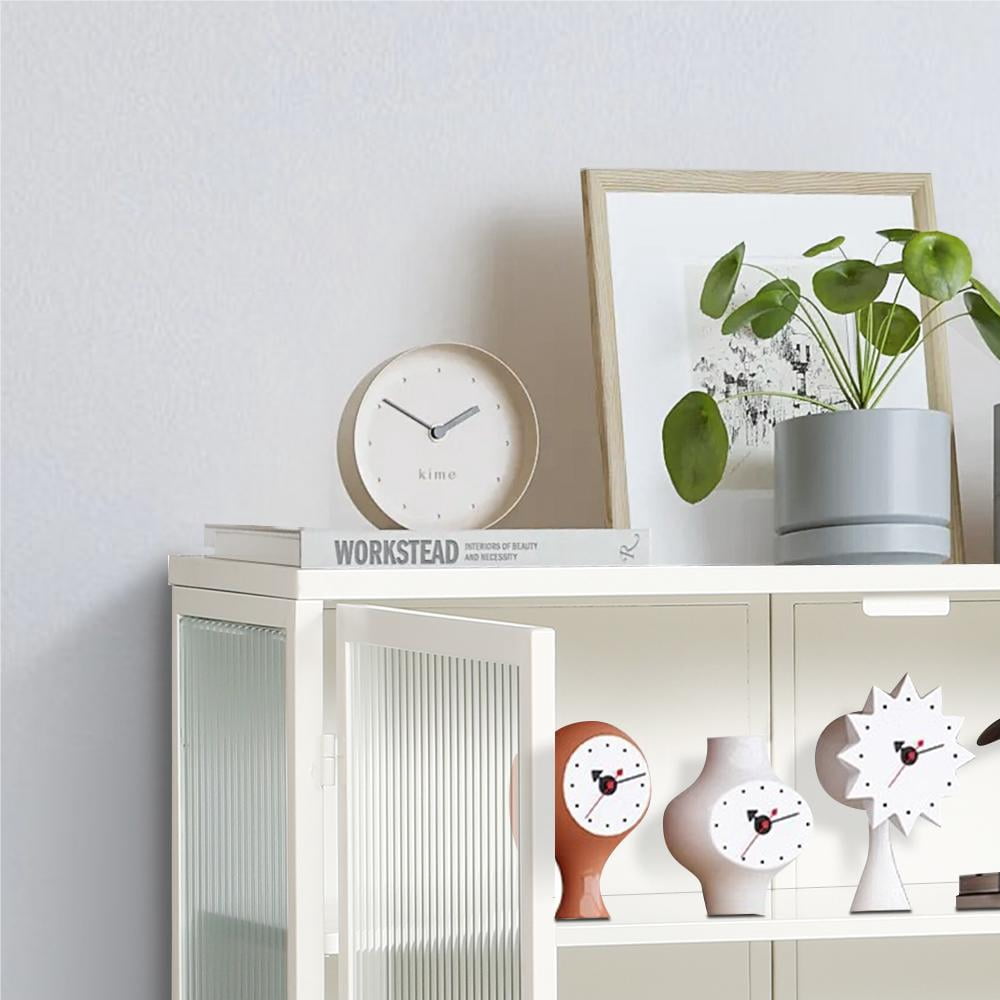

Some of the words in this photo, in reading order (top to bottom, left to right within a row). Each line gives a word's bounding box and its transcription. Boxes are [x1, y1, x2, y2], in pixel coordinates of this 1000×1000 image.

[418, 466, 456, 480] kime
[464, 542, 501, 550] INTERIORS
[502, 542, 511, 550] OF
[512, 542, 538, 550] BEAUTY
[334, 539, 459, 565] WORKSTEAD
[464, 553, 479, 561] AND
[481, 553, 518, 561] NECESSITY
